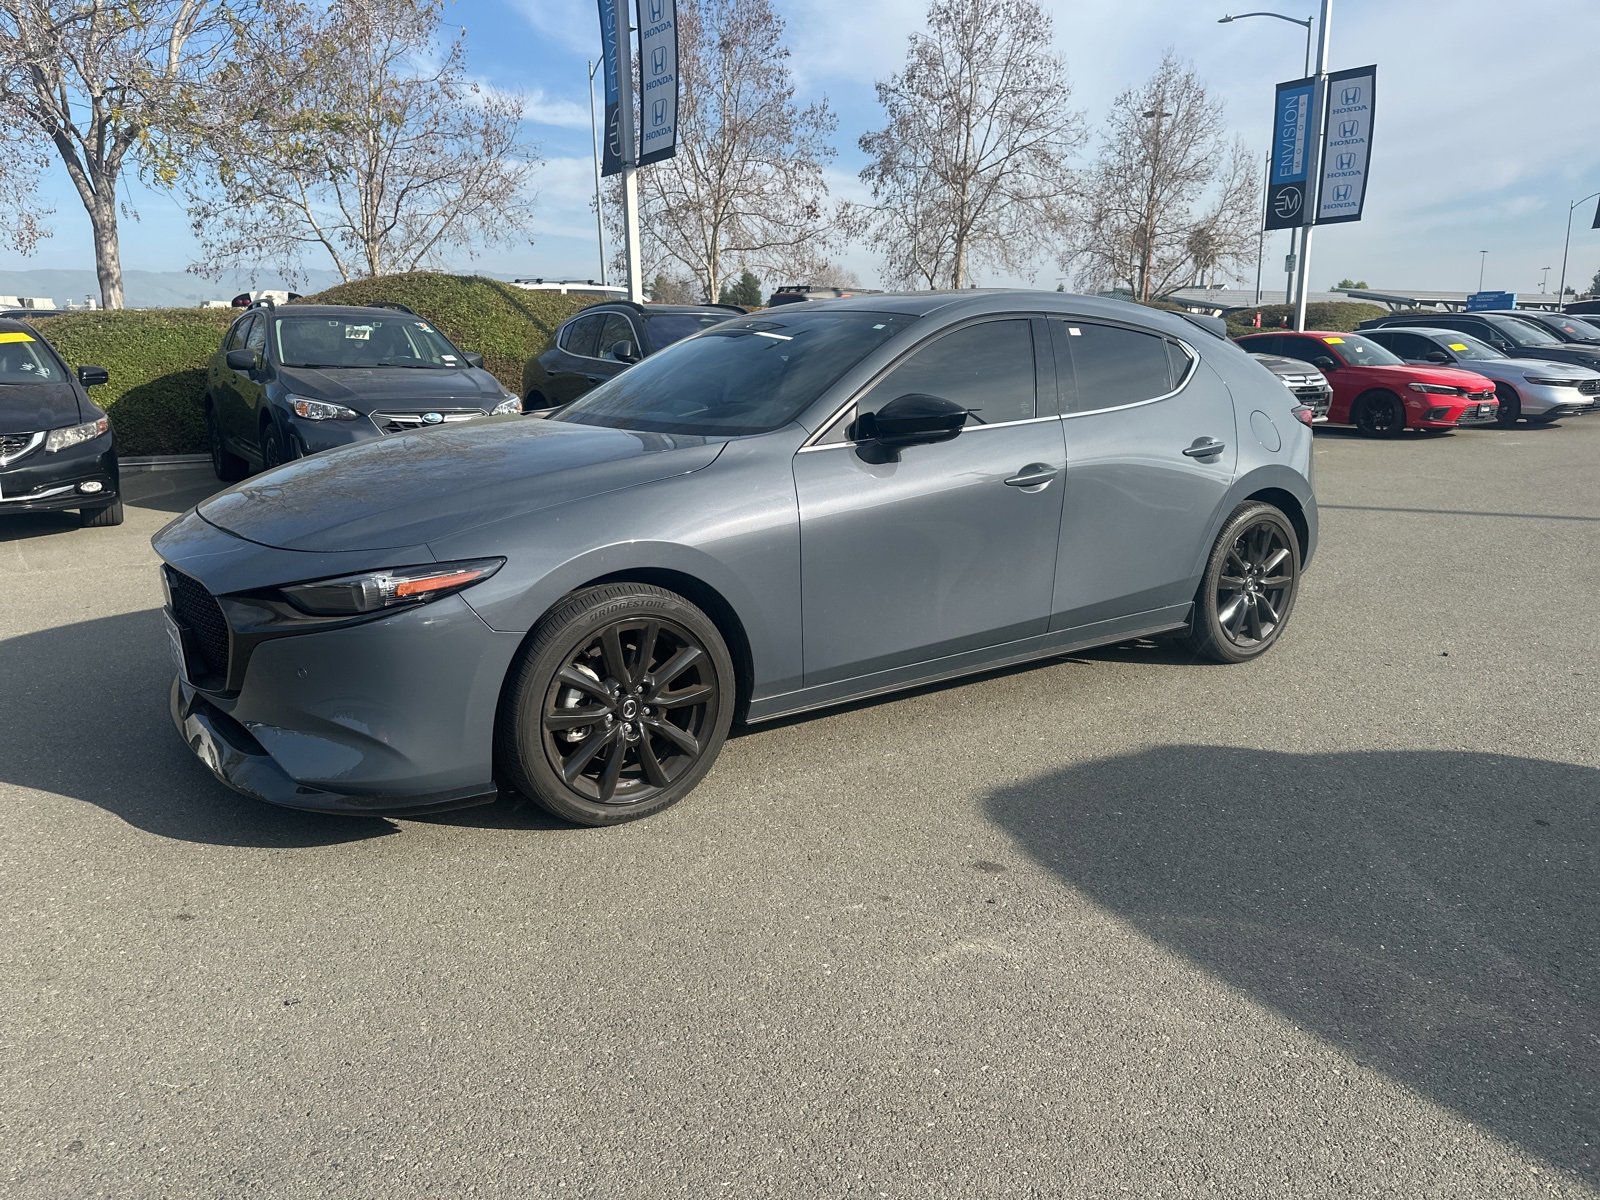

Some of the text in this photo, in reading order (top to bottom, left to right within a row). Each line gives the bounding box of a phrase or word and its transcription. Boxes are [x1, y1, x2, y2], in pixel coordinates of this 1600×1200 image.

[643, 20, 672, 40] HONDA
[646, 74, 673, 91] HONDA
[1332, 105, 1368, 114] HONDA
[645, 126, 672, 142] HONDA
[1280, 96, 1298, 177] ENVISION
[1294, 101, 1307, 169] MOTORS
[1330, 138, 1365, 147] HONDA
[1327, 170, 1362, 179] HONDA
[1323, 202, 1357, 210] HONDA
[589, 600, 668, 621] BRIDGESTONE
